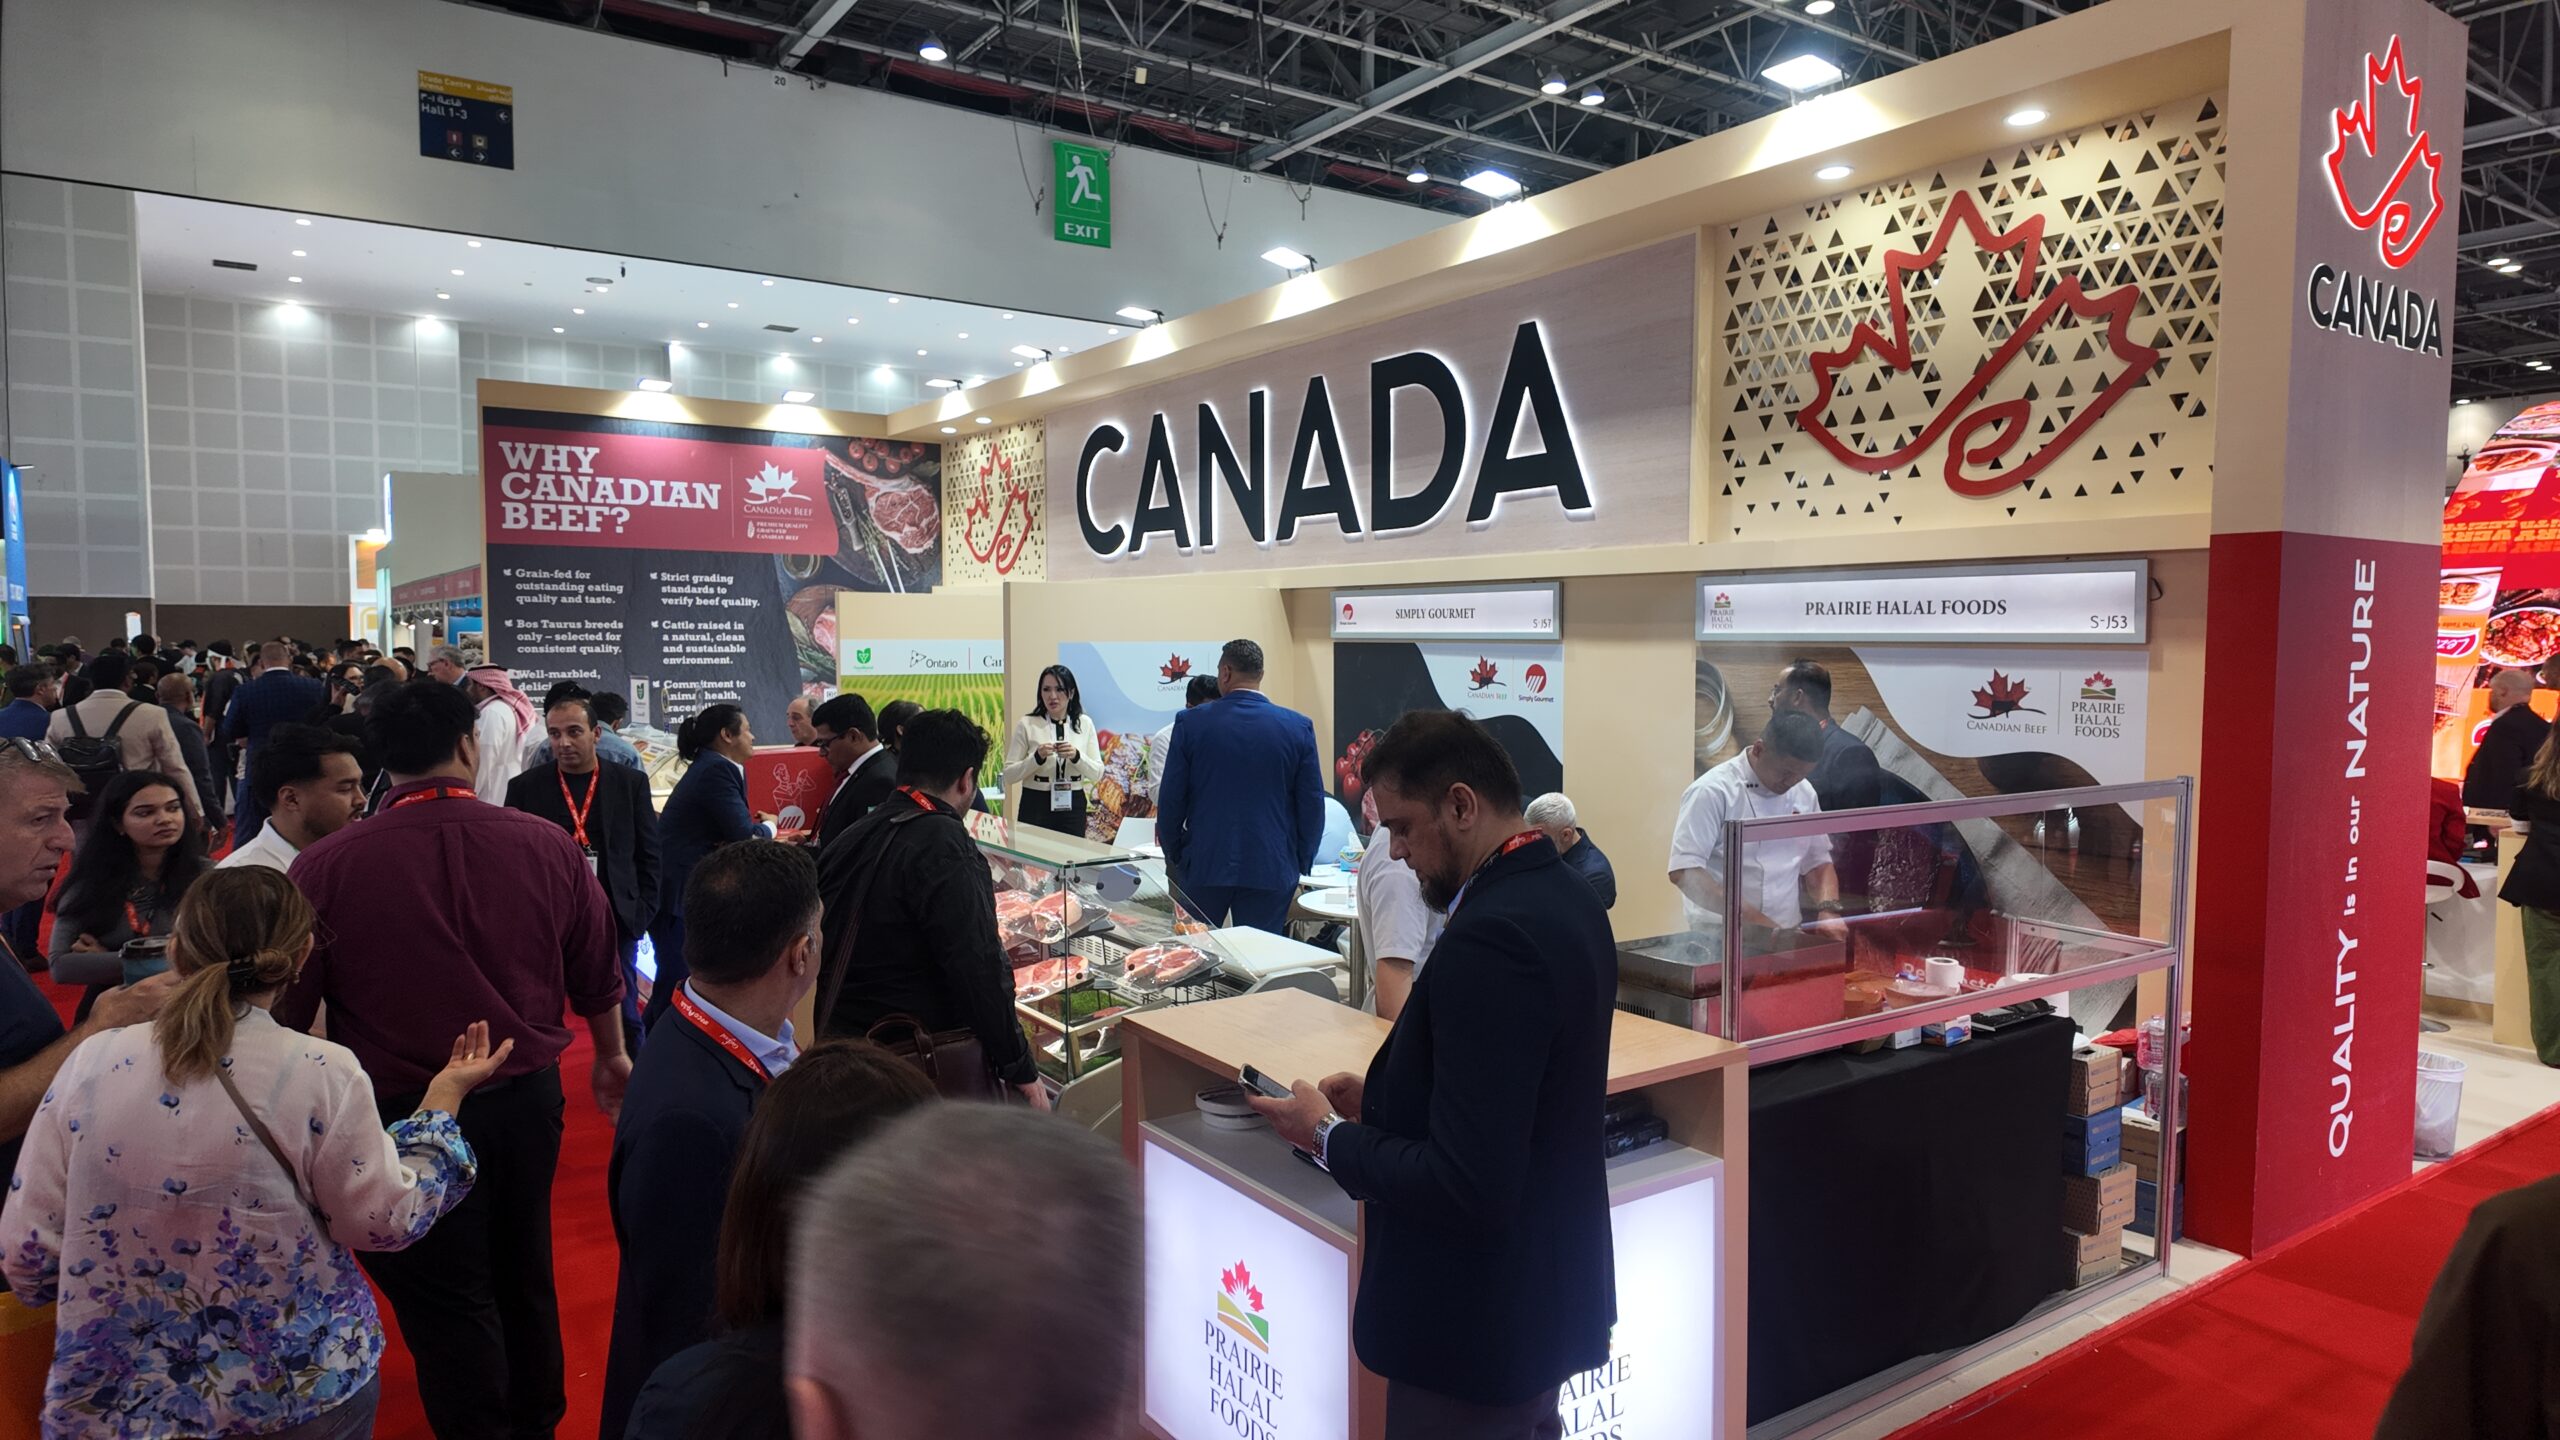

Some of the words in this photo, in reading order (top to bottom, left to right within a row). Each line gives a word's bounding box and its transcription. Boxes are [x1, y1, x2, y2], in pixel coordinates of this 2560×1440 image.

[774, 75, 786, 86] 20
[421, 103, 446, 116] Hall
[448, 108, 468, 120] 1-3
[1063, 222, 1101, 240] EXIT
[2307, 262, 2443, 359] CANADA
[1075, 320, 1594, 556] CANADA
[498, 441, 600, 474] WHY
[500, 472, 722, 510] CANADIAN
[743, 504, 792, 515] CANADIAN
[794, 507, 813, 516] BEEF
[501, 502, 631, 534] BEEF?
[515, 568, 572, 579] Grain-fed
[575, 570, 591, 579] for
[661, 572, 690, 582] Strict
[692, 574, 734, 585] grading
[515, 582, 585, 593] outstanding
[587, 583, 624, 594] eating
[661, 585, 714, 594] standards
[717, 586, 727, 594] to
[515, 594, 558, 605] quality
[560, 595, 582, 604] and
[585, 595, 616, 604] taste.
[661, 596, 693, 607] verify
[695, 597, 720, 606] beef
[721, 597, 760, 608] quality.
[1395, 607, 1426, 620] SIMPLY
[1428, 607, 1476, 620] GOURMET
[1804, 599, 1873, 617] PRAIRIE
[1876, 599, 1938, 617] HALAL
[1940, 598, 2008, 617] FOODS
[516, 619, 539, 629] Bos
[540, 620, 582, 629] Taurus
[584, 620, 624, 629] breeds
[662, 620, 695, 630] Cattle
[697, 621, 731, 630] raised
[733, 621, 744, 630] in
[2089, 614, 2129, 630] S-J53
[517, 632, 543, 643] only
[554, 632, 603, 641] selected
[605, 632, 621, 641] for
[671, 632, 714, 643] natural,
[716, 633, 745, 641] clean
[517, 644, 577, 653] consistent
[579, 644, 622, 655] quality.
[663, 644, 683, 653] and
[685, 644, 746, 653] sustainable
[663, 656, 733, 665] environment.
[925, 658, 958, 668] Ontario
[519, 669, 601, 680] Well-marbled,
[736, 680, 746, 688] to
[704, 692, 741, 701] health,
[1518, 694, 1533, 702] Simply
[2071, 701, 2126, 714] PRAIRIE
[2074, 713, 2121, 726] HALAL
[1966, 720, 2021, 732] CANADIAN
[2024, 723, 2047, 734] BEEF
[2074, 725, 2120, 738] FOODS
[2328, 928, 2359, 1158] QUALITY
[2345, 558, 2376, 779] NATURE
[1204, 1318, 1284, 1401] PRAIRIE
[1209, 1353, 1278, 1430] HALAL
